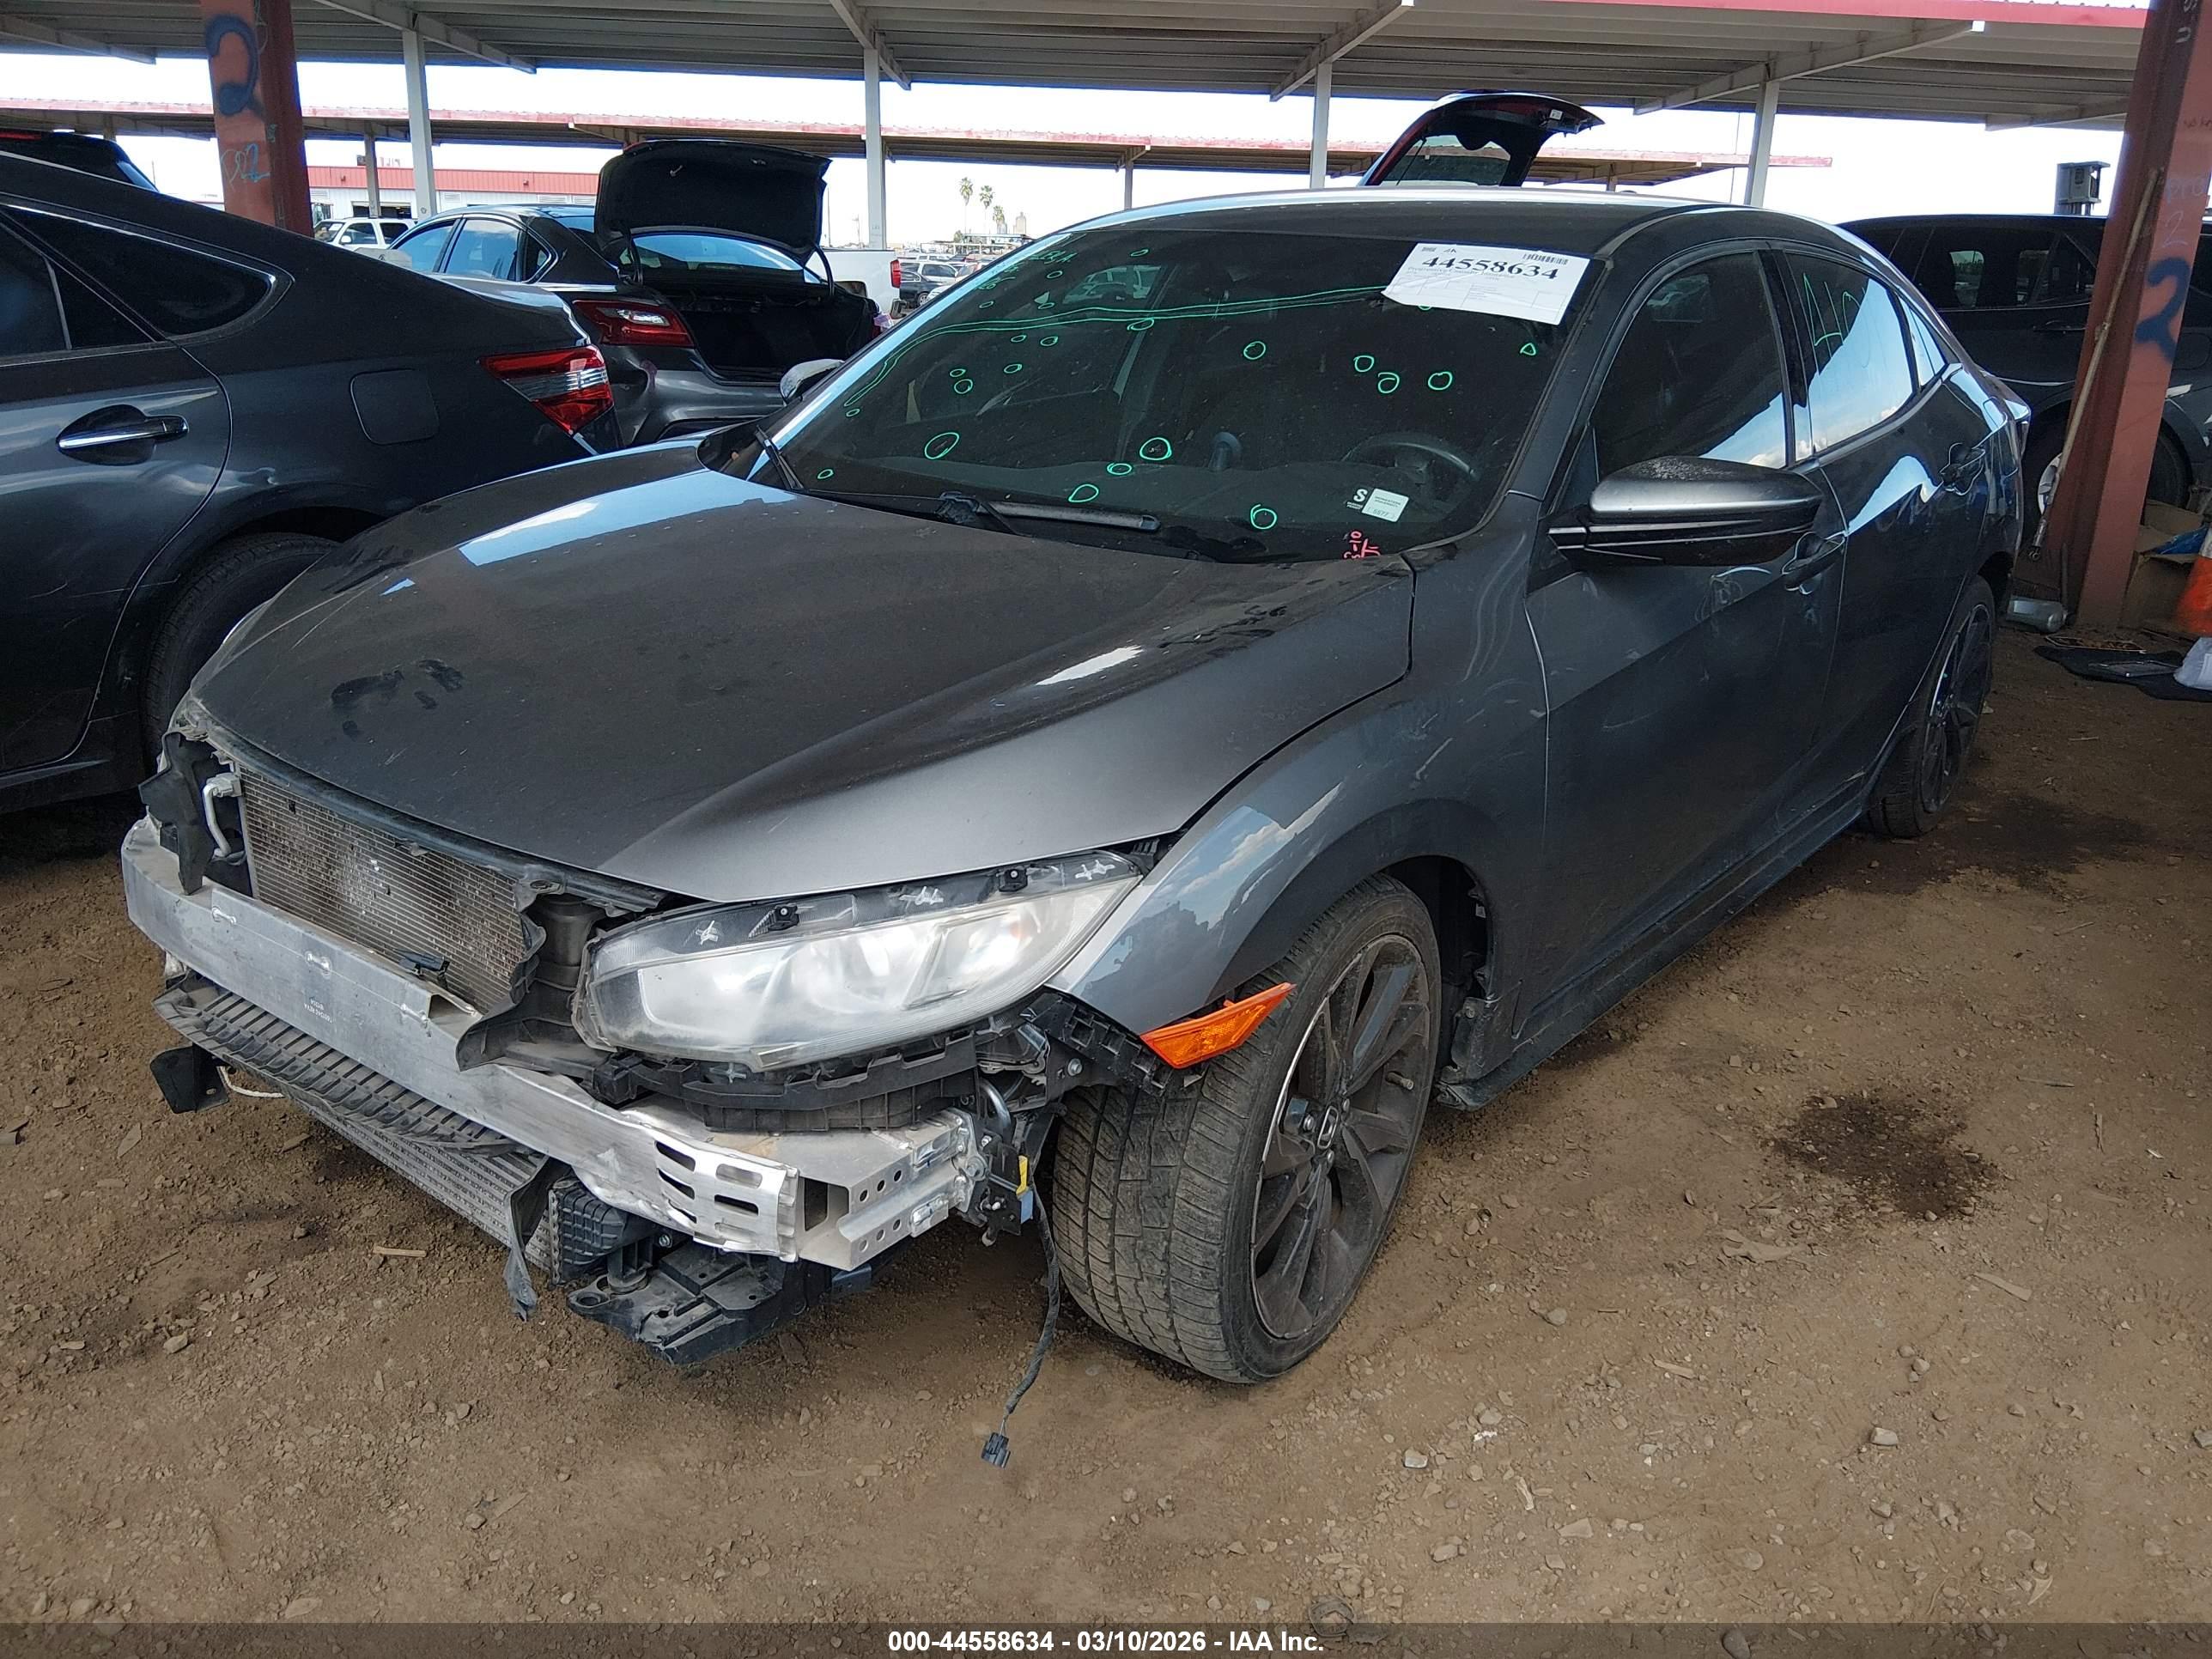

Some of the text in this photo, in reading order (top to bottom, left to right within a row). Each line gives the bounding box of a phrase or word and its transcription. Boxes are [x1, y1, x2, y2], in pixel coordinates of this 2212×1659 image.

[1422, 257, 1559, 279] 44558634
[2134, 257, 2191, 363] 2
[1353, 489, 1368, 502] S
